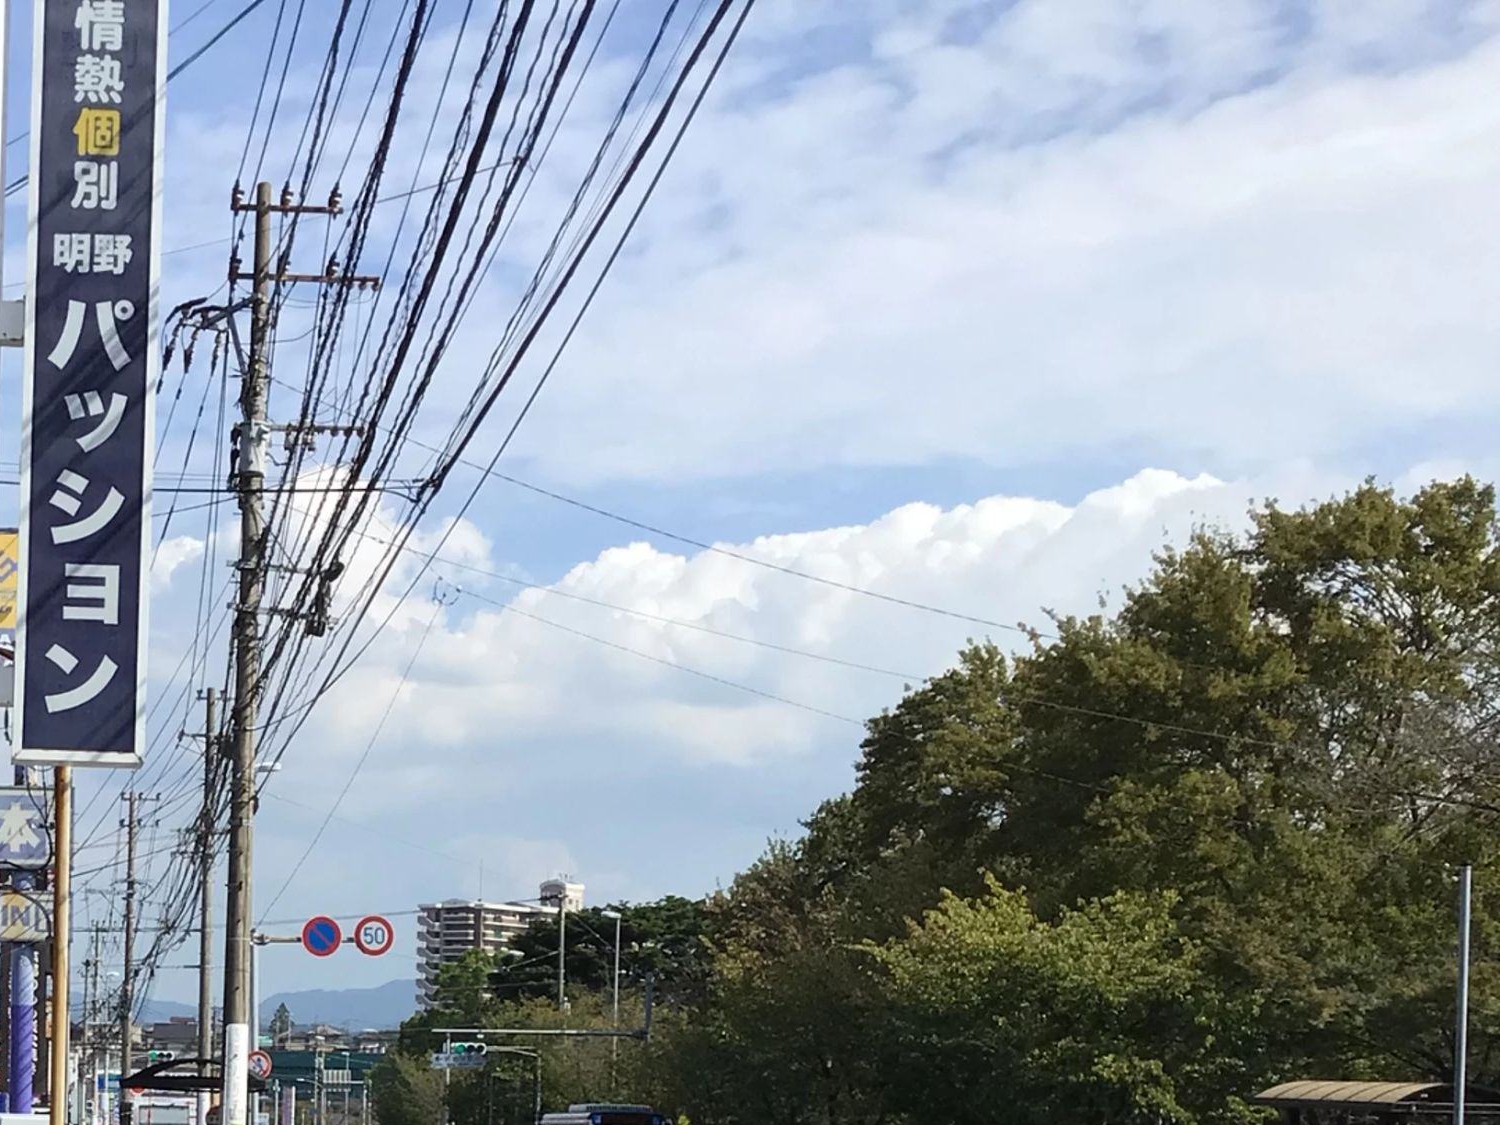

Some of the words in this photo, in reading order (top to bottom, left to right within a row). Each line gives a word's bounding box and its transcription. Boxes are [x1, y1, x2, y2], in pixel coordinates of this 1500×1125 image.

[71, 0, 125, 210] 情熱個別
[53, 233, 133, 276] 明野
[45, 299, 136, 714] パッション
[363, 927, 385, 945] 50
